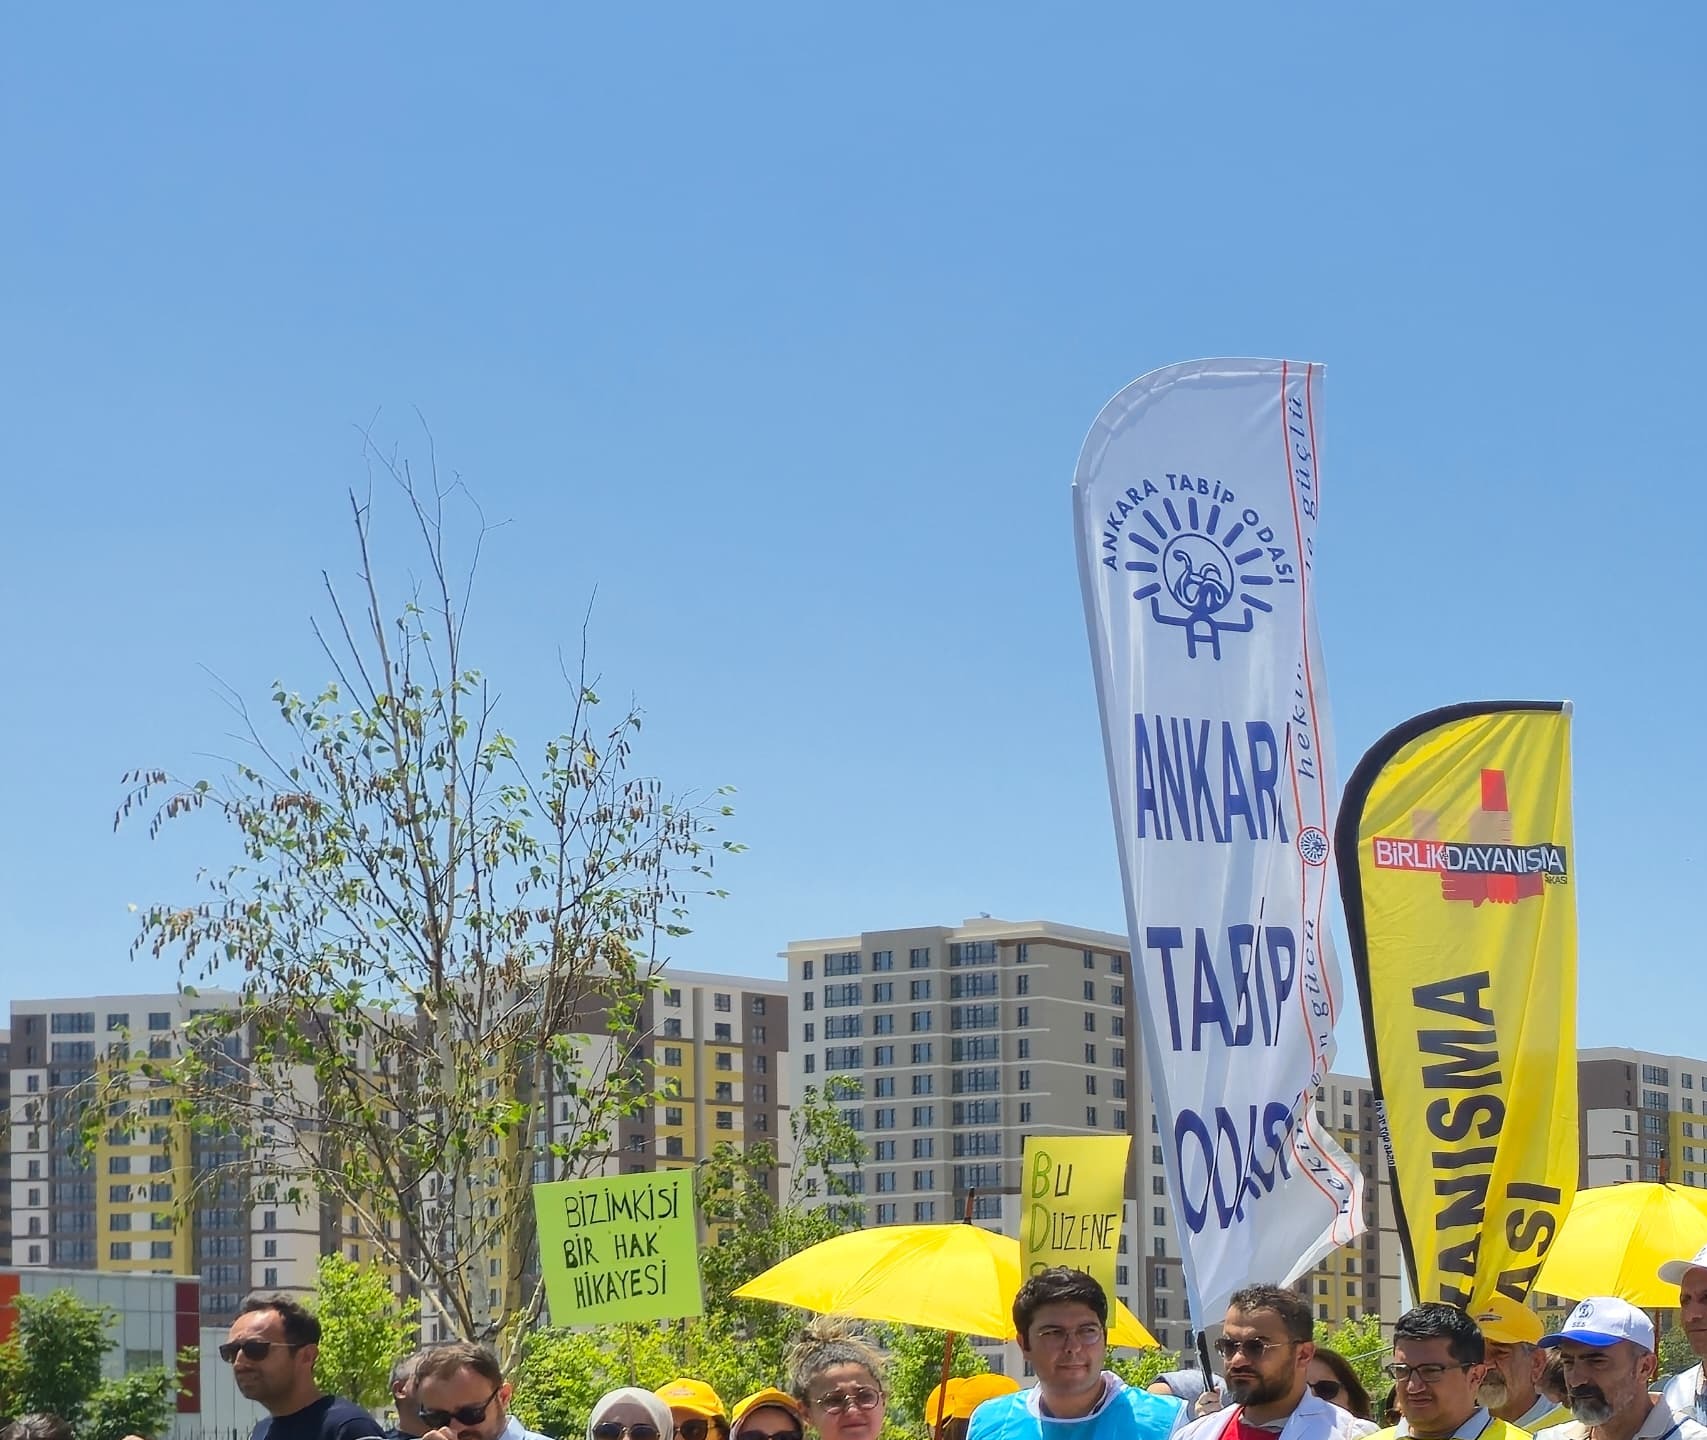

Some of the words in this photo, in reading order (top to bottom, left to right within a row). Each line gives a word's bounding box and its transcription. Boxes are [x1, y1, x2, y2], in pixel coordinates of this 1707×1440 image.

[1102, 478, 1159, 571] ANKARA
[1165, 473, 1236, 506] TABİP
[1242, 508, 1296, 585] ODASI
[1135, 713, 1290, 843] ANKAR
[565, 1181, 679, 1228] BİZİMKİSİ
[1029, 1203, 1117, 1253] DÜZENE
[563, 1233, 599, 1268] BİR
[574, 1260, 666, 1309] HİKAYESİ
